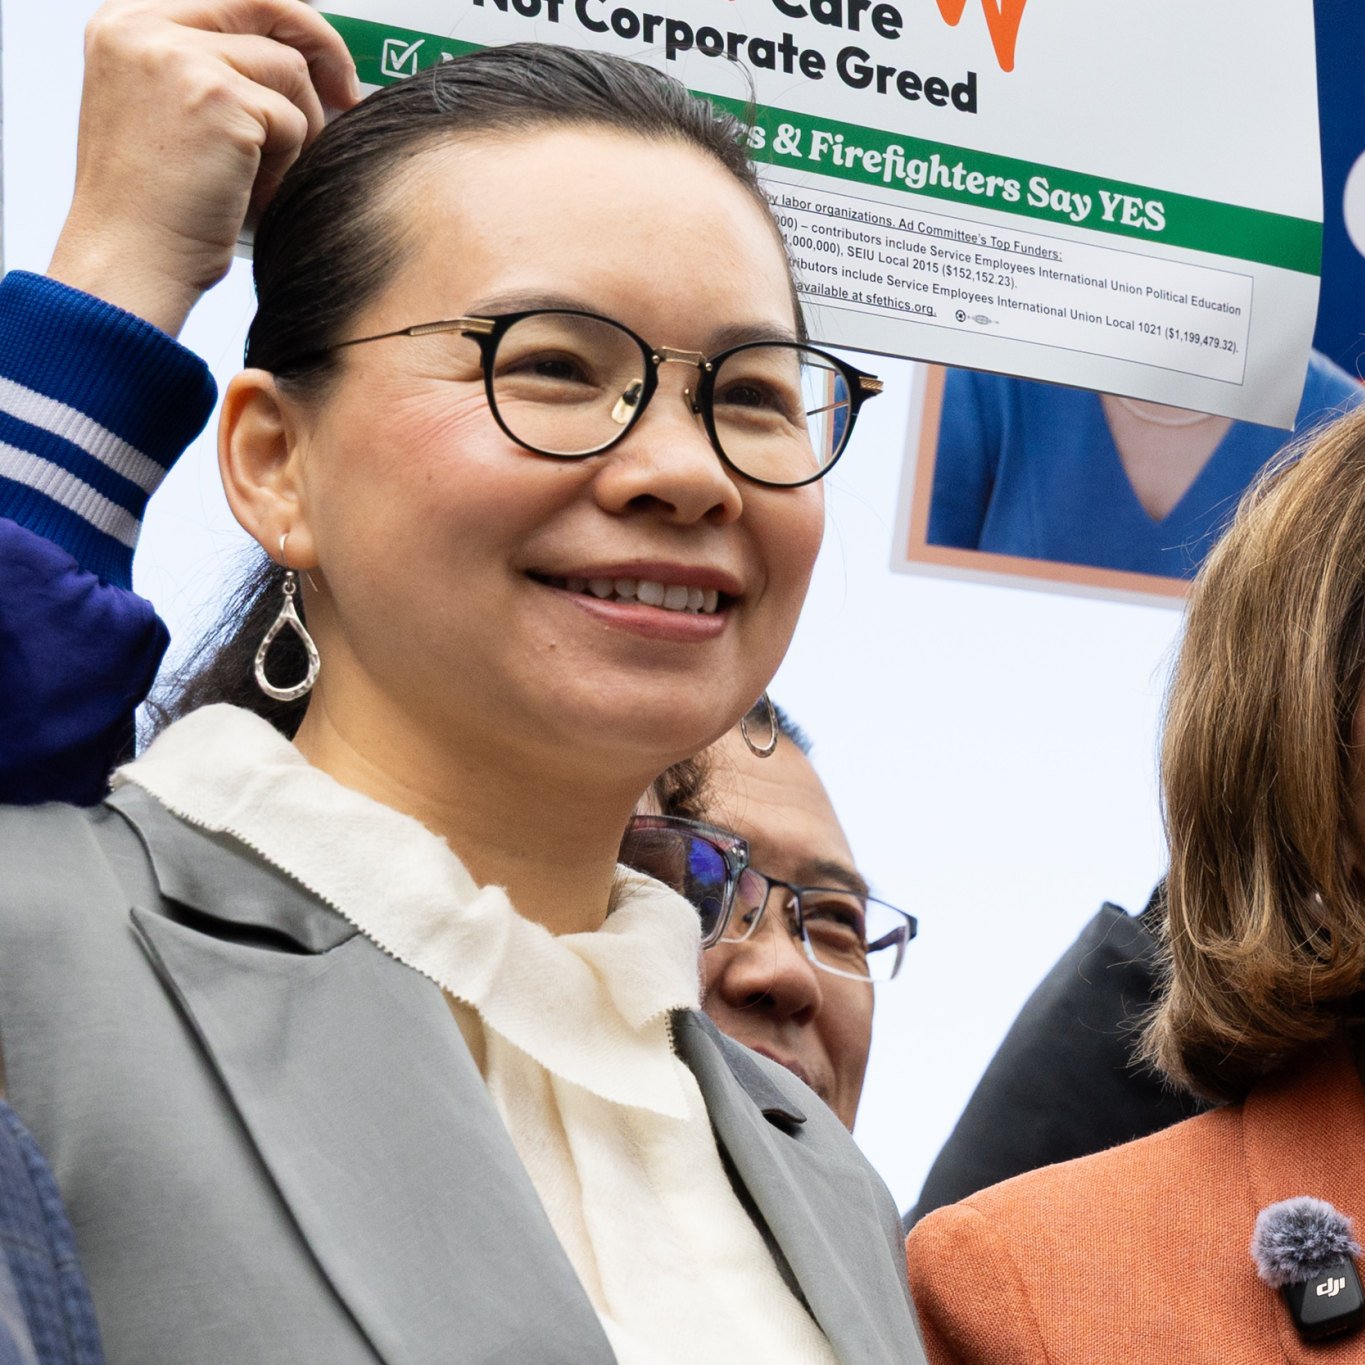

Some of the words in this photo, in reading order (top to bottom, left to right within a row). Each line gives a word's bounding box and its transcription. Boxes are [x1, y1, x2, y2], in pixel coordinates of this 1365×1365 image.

[575, 0, 826, 80] Corporate
[837, 46, 978, 114] Greed
[773, 123, 803, 158] &
[807, 129, 1021, 202] Firefighters
[1026, 176, 1092, 222] Say
[1097, 190, 1167, 232] YES
[782, 194, 811, 210] labor
[815, 202, 894, 228] organizations.
[898, 218, 914, 231] Ad
[917, 221, 986, 244] Committee's
[990, 236, 1010, 252] Top
[1013, 240, 1061, 260] Funders:
[811, 224, 881, 245] contributors
[885, 236, 926, 254] include
[930, 245, 971, 262] Service
[974, 253, 1035, 275] Employees
[1038, 266, 1107, 288] International
[1110, 280, 1142, 294] Union
[1145, 286, 1187, 303] Political
[1191, 295, 1240, 314] Education
[847, 245, 874, 260] SEIU
[878, 251, 908, 267] Local
[912, 258, 938, 273] 2015
[942, 263, 1017, 290] ($152,152.23).
[797, 282, 848, 298] available
[852, 290, 863, 302] at
[841, 266, 882, 283] include
[886, 274, 928, 291] Service
[932, 283, 993, 304] Employees
[997, 296, 1066, 317] International
[1070, 308, 1102, 323] Union
[1105, 315, 1134, 329] Local
[1138, 322, 1160, 335] 1021
[1165, 327, 1239, 353] ($1,199,479.32).
